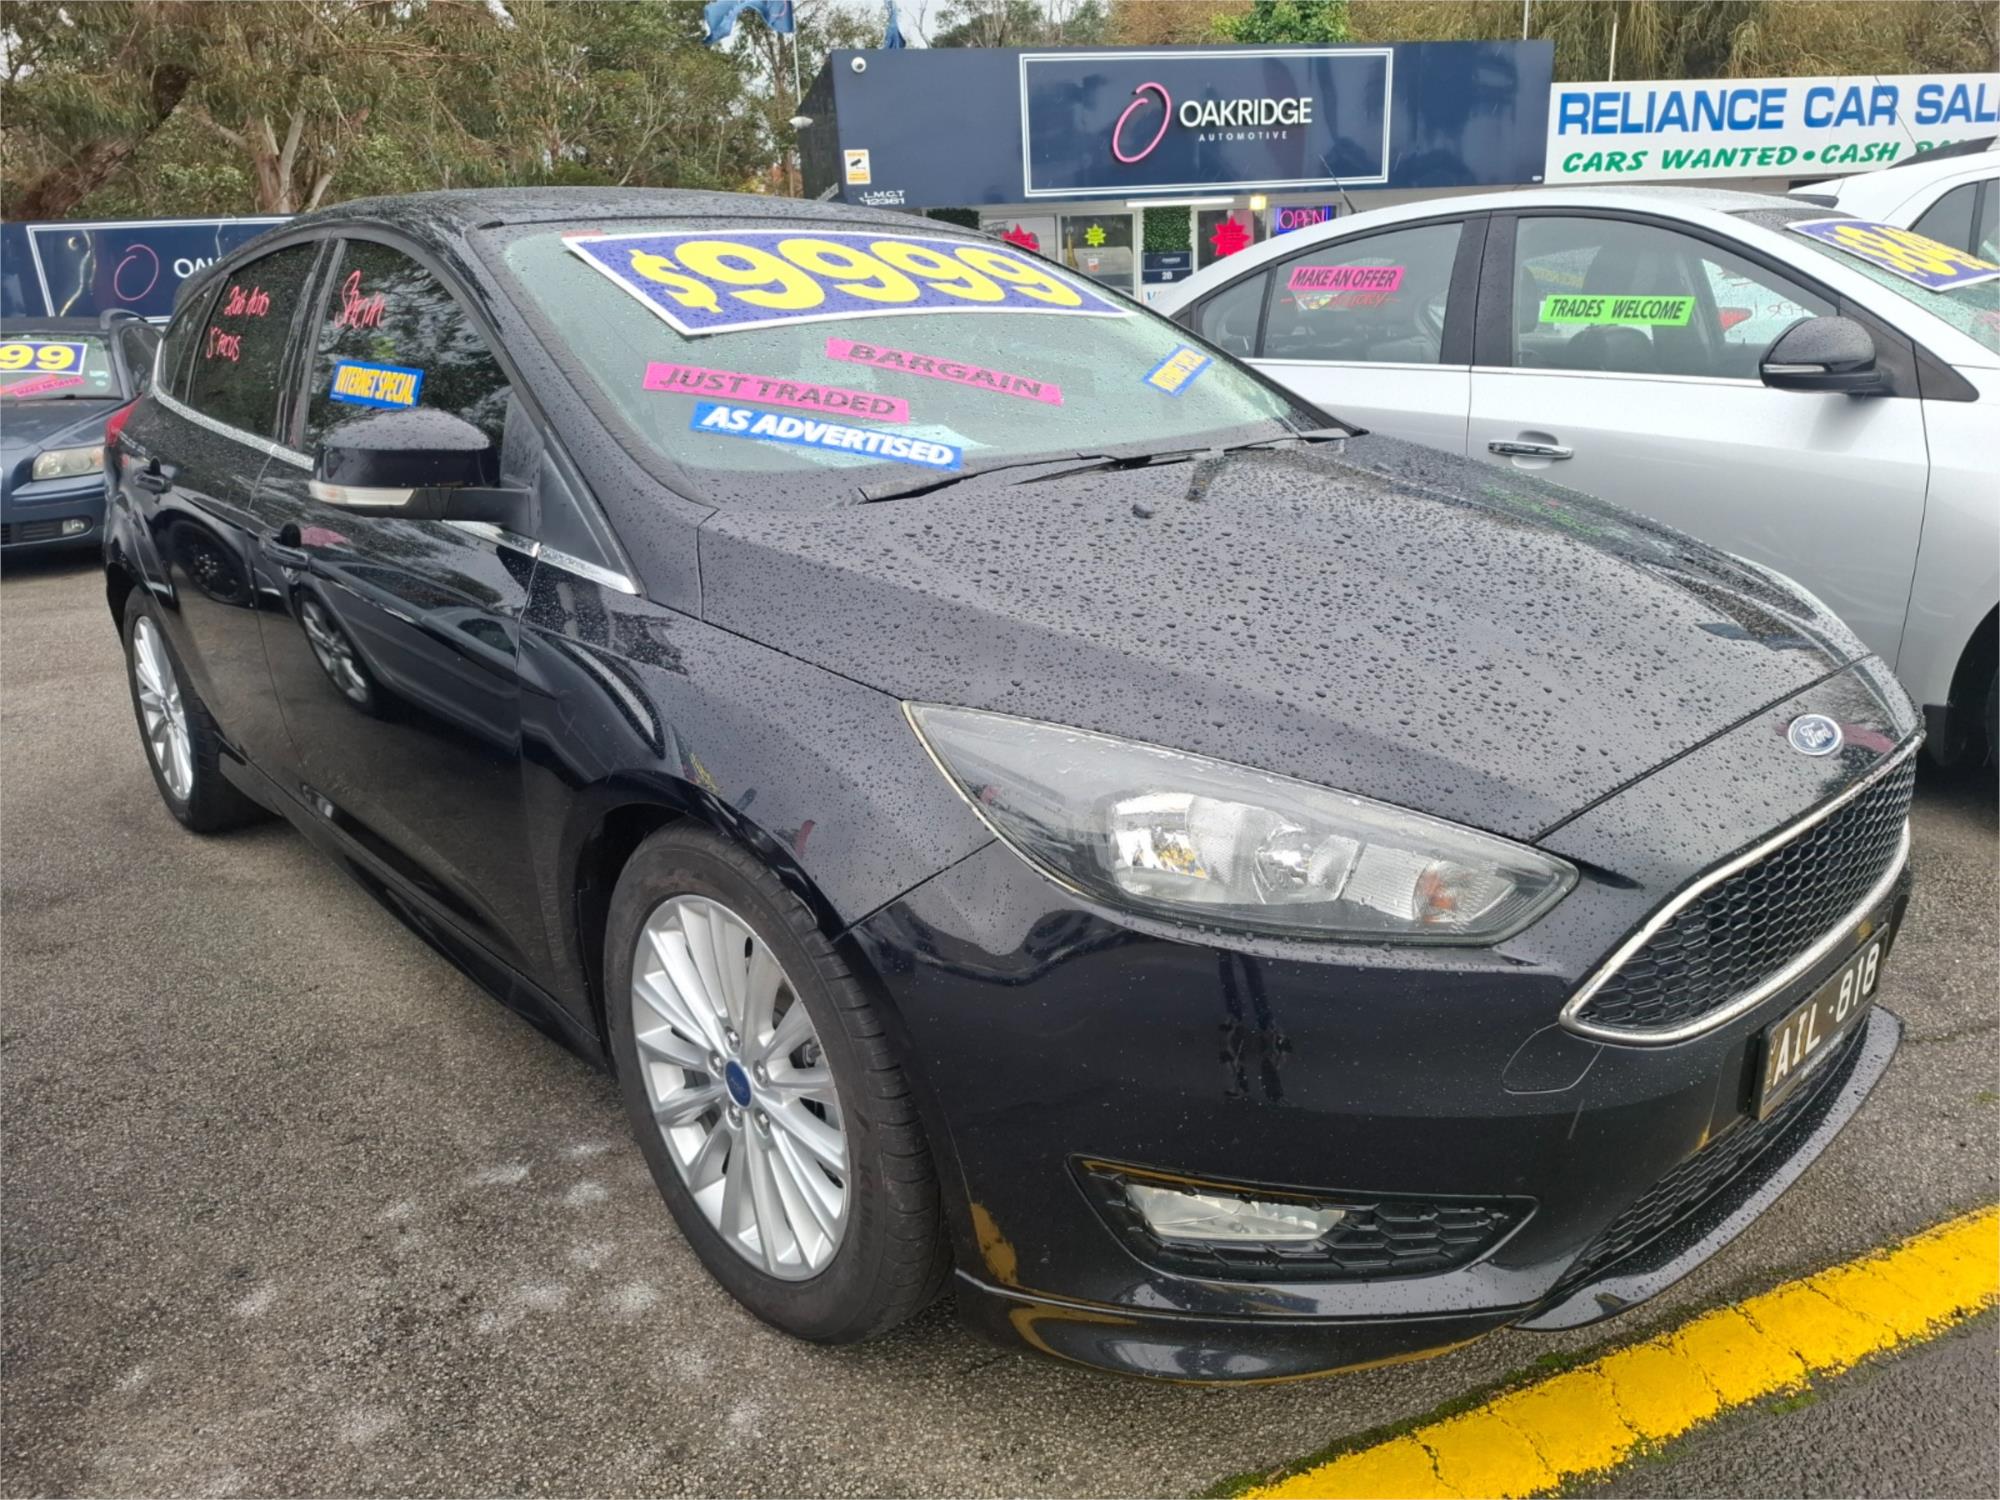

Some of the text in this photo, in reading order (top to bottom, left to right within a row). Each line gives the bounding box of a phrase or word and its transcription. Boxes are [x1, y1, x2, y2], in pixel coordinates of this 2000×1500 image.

[1179, 97, 1313, 127] OAKRIDGE
[1558, 83, 2000, 135] RELIANCE CAR SAL
[1198, 131, 1287, 142] AUTOMOTIVE
[1562, 150, 1649, 173] CARS
[1661, 146, 1798, 169] WANTED
[1820, 142, 1901, 164] CASH
[1280, 209, 1326, 229] OPEN
[628, 238, 1083, 313] $9999
[1292, 269, 1397, 288] MAKE AN OFFER
[1550, 298, 1686, 320] TRADES WELCOME
[849, 344, 1043, 397] BARGAIN
[660, 367, 896, 415] JUST TRADED
[701, 406, 954, 465] AS ADVERTISED
